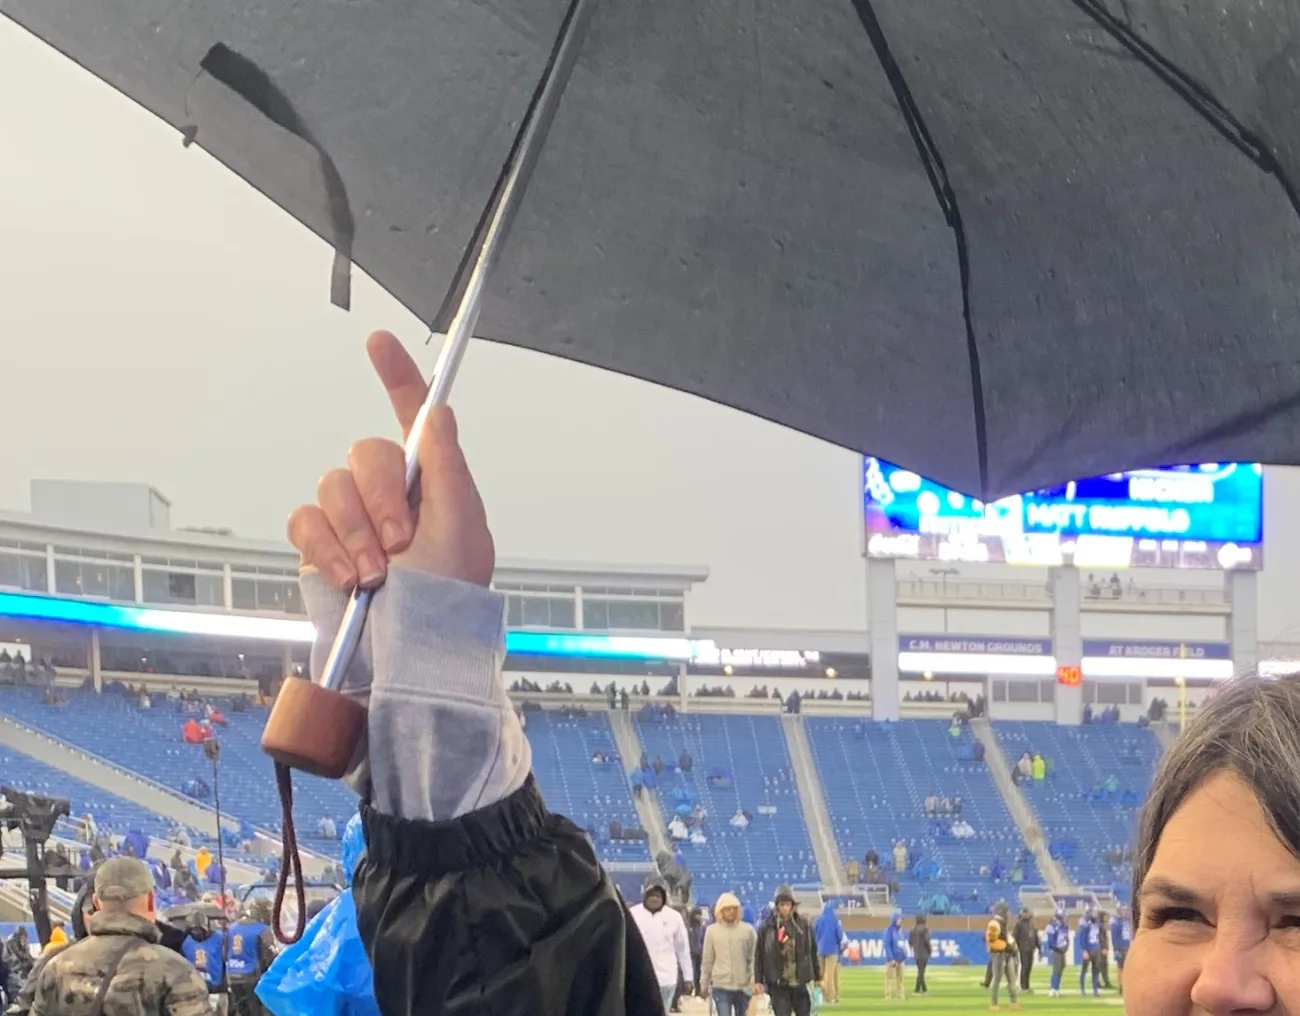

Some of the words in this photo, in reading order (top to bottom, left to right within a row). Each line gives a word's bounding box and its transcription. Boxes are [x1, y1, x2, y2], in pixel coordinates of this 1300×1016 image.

[1027, 502, 1087, 529] MATT
[909, 639, 932, 650] C.M.
[935, 641, 984, 652] NEWTON
[987, 642, 1043, 653] GROUNDS
[1108, 645, 1123, 656] AT
[1125, 645, 1171, 657] KROGER
[1173, 646, 1205, 657] FELD
[1057, 666, 1080, 686] 40
